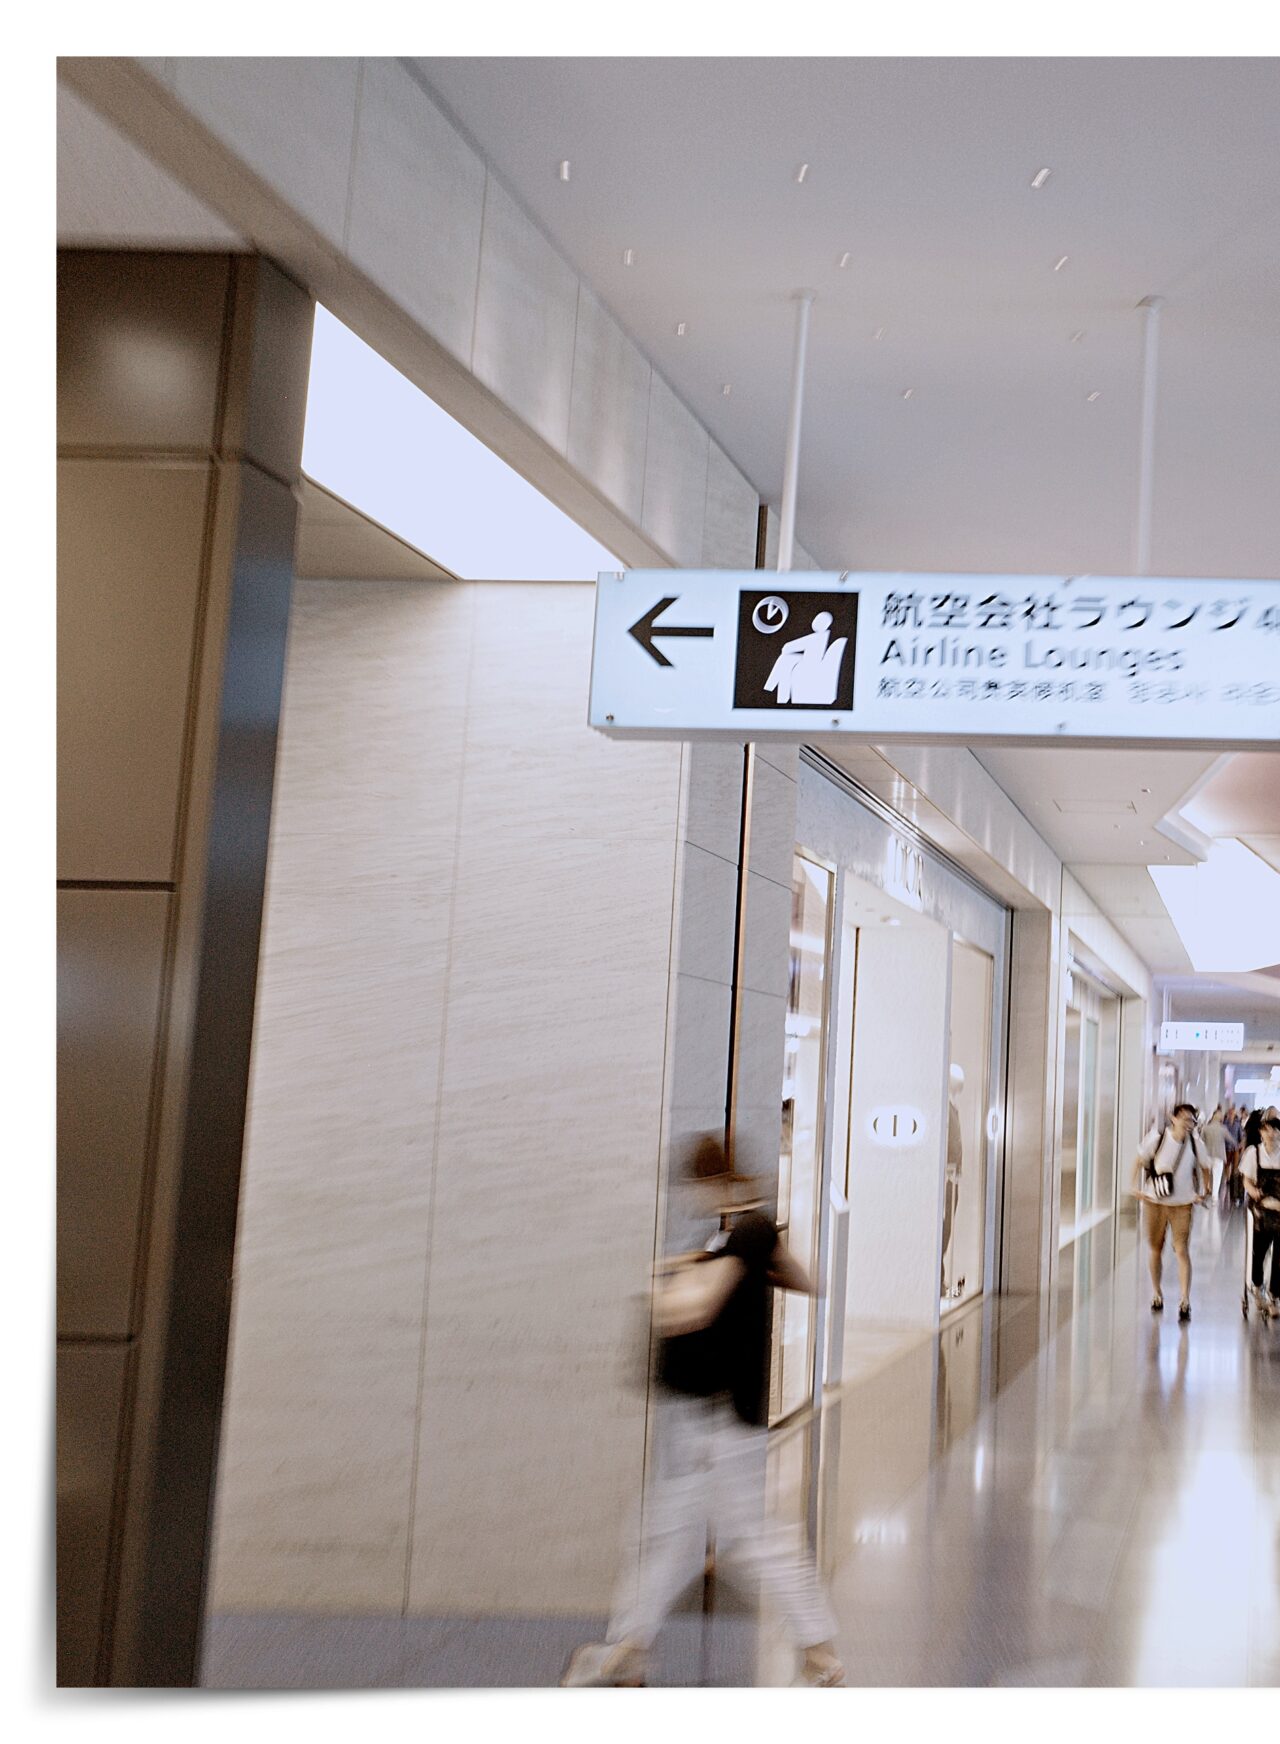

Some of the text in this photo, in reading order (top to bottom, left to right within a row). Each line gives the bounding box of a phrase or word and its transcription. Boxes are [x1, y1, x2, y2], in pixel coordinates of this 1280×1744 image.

[881, 590, 1250, 631] 航空会社ラウンジ
[879, 636, 1183, 677] Airline Lounges
